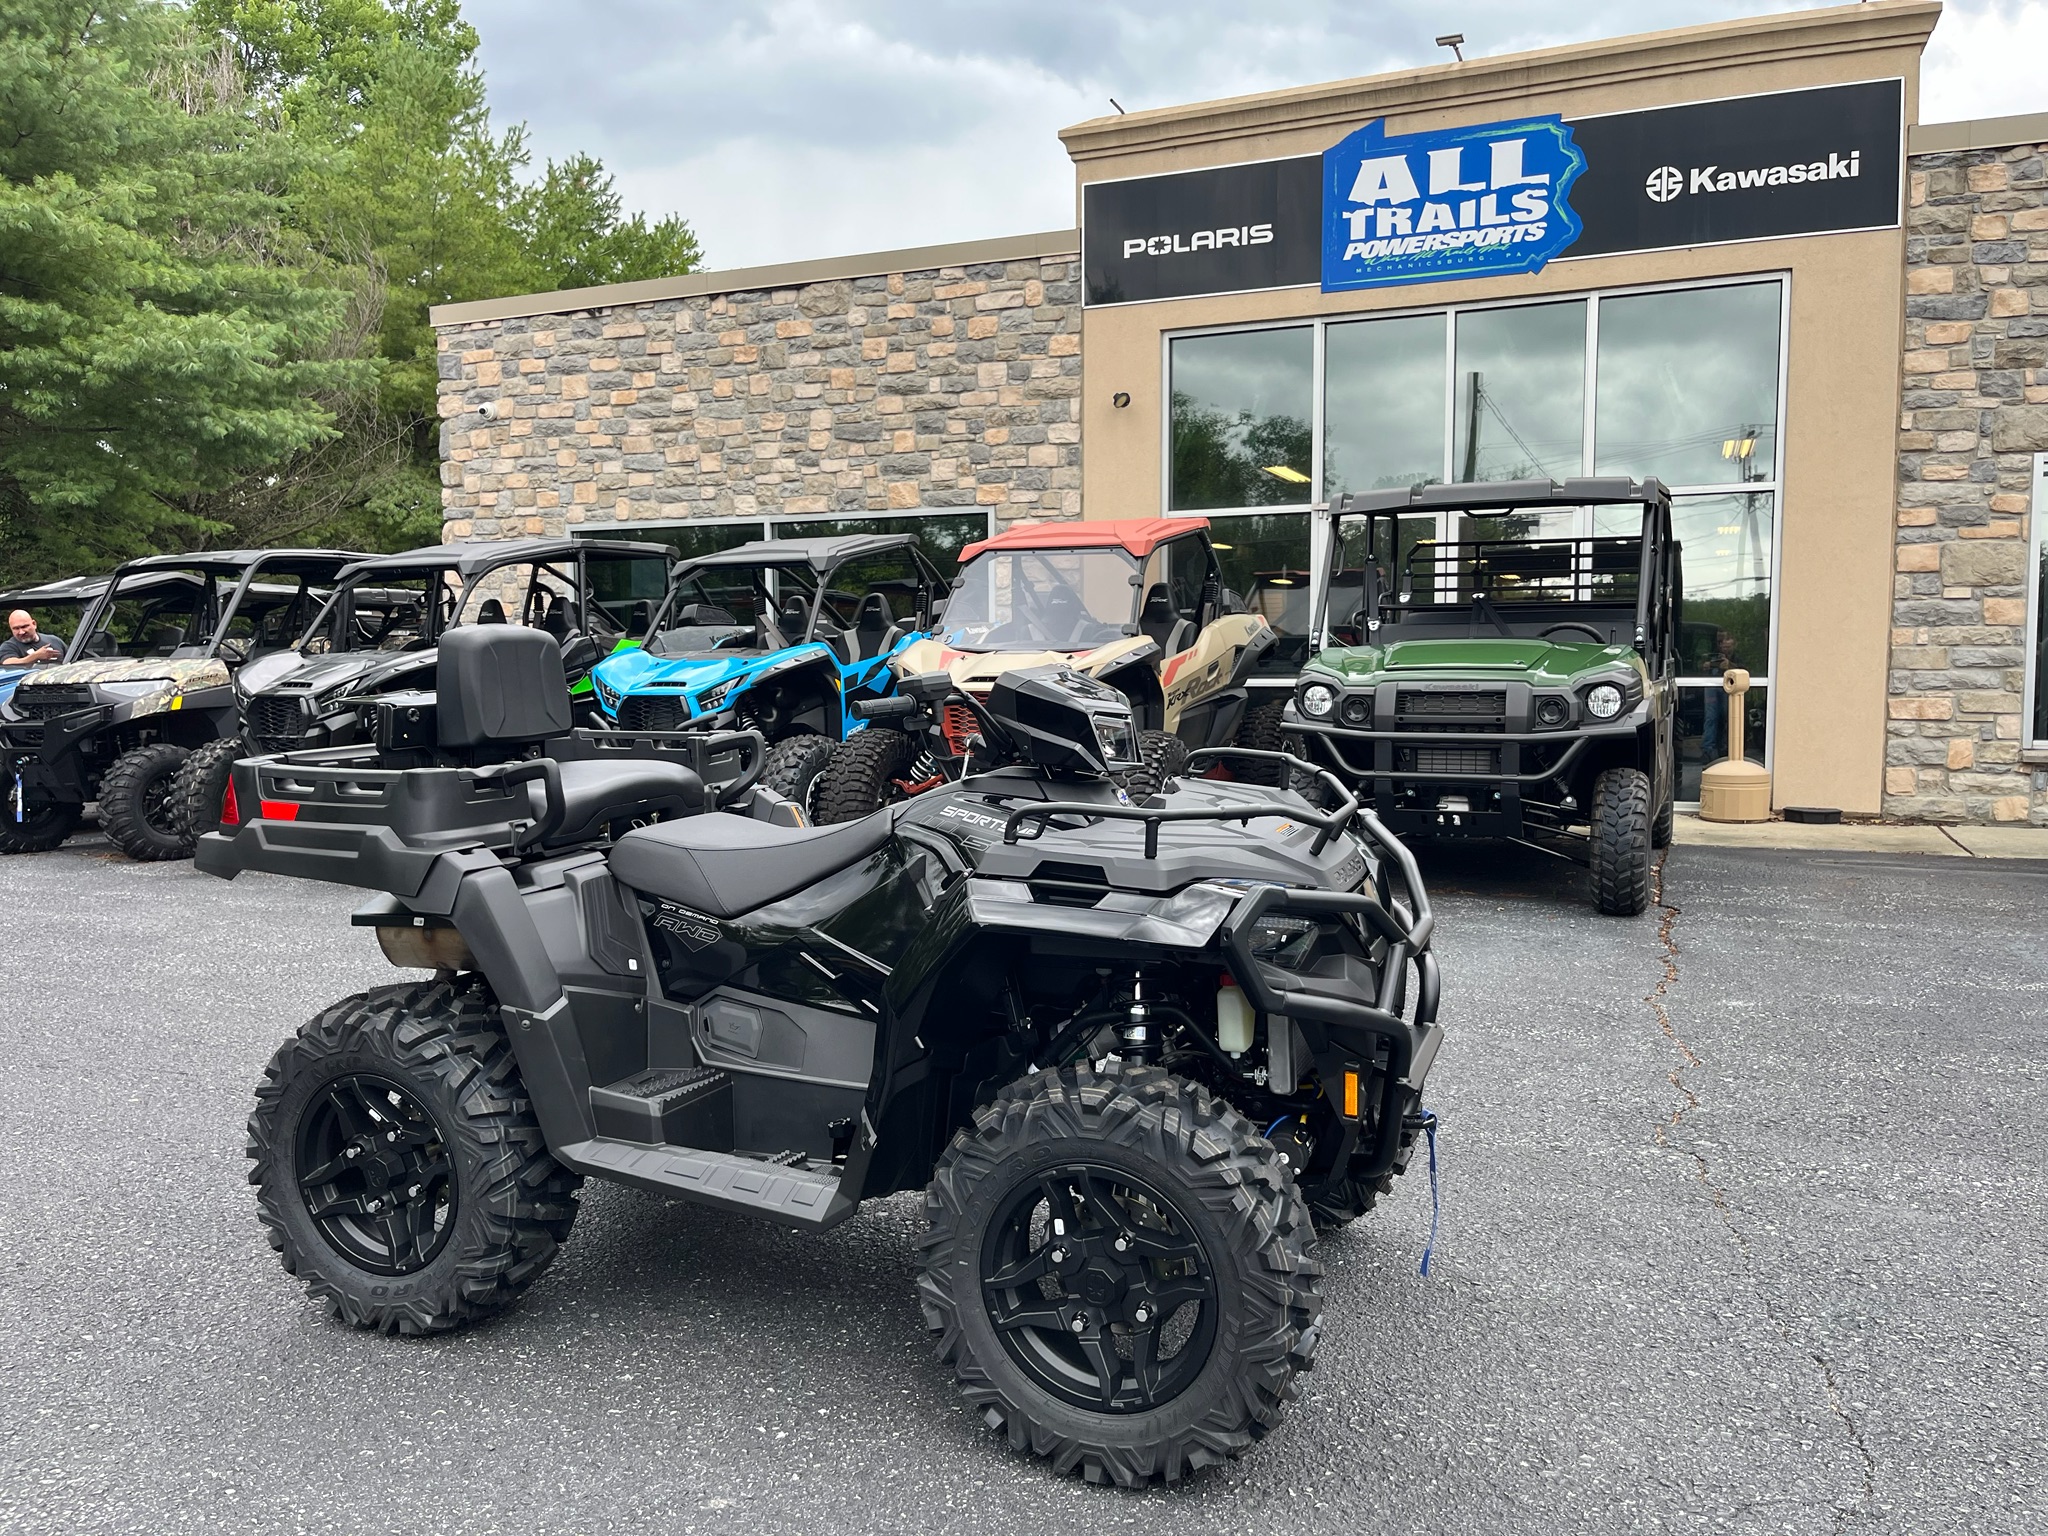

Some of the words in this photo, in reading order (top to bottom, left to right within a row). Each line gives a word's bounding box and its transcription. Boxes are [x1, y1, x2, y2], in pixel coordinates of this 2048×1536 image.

[1348, 138, 1550, 206] ALL
[1689, 150, 1860, 194] Kawasaki
[1342, 189, 1549, 241] TRAILS
[1123, 223, 1274, 259] POLARIS
[1343, 221, 1548, 261] POWERSPORTS
[653, 914, 721, 944] AWD
